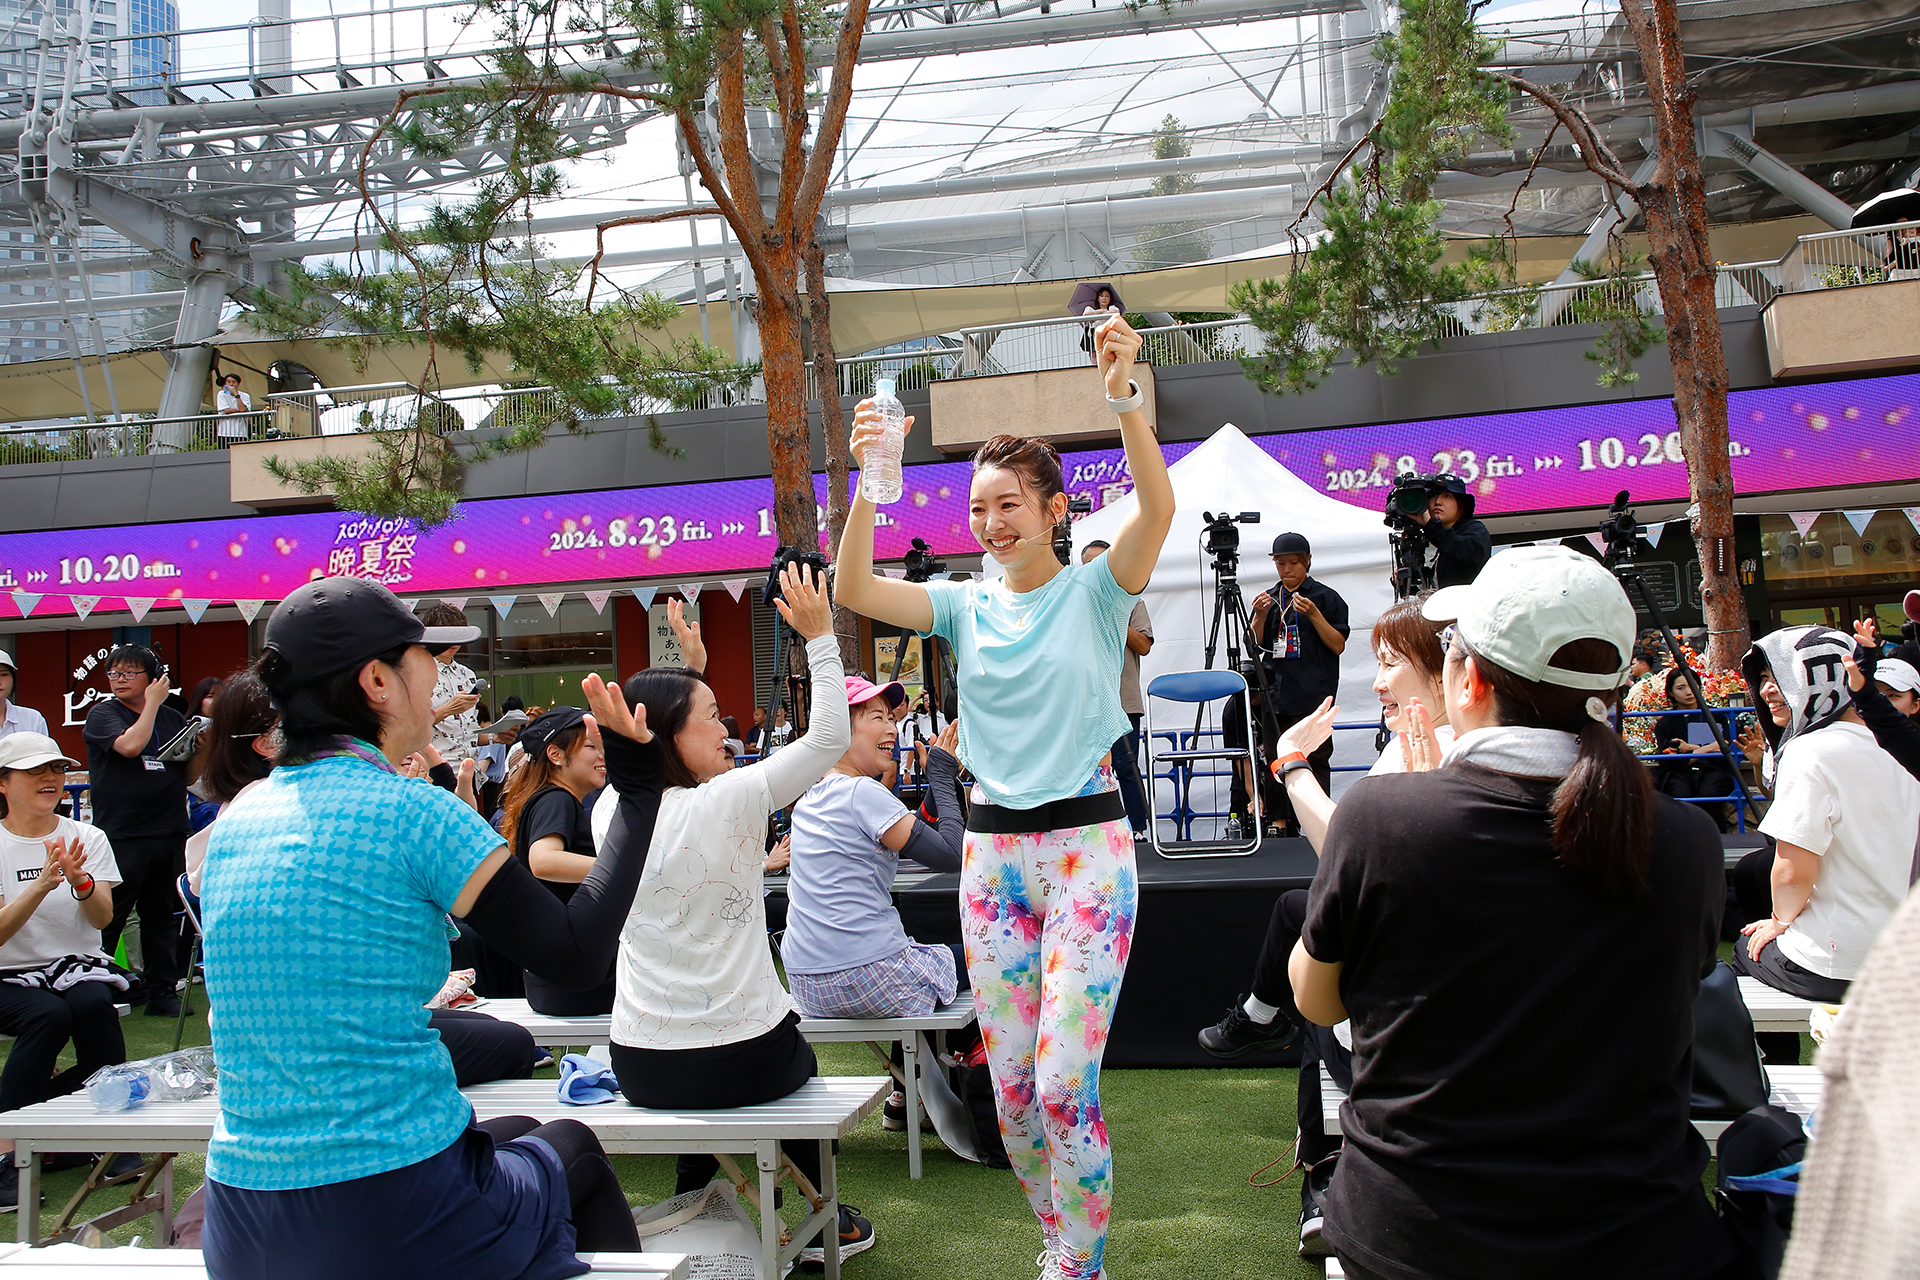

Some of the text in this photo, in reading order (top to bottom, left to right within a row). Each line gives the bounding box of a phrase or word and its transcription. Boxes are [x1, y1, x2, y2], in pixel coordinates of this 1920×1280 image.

[1326, 469, 1391, 490] 2024.
[1396, 450, 1480, 484] 823
[1486, 455, 1523, 477] fri.
[550, 529, 604, 550] 2024.
[609, 515, 678, 547] 8.23
[682, 520, 713, 540] fri.
[0, 554, 181, 586] ri. 10.20 sun.
[328, 534, 417, 577] 晩夏祭
[658, 653, 681, 662] パス
